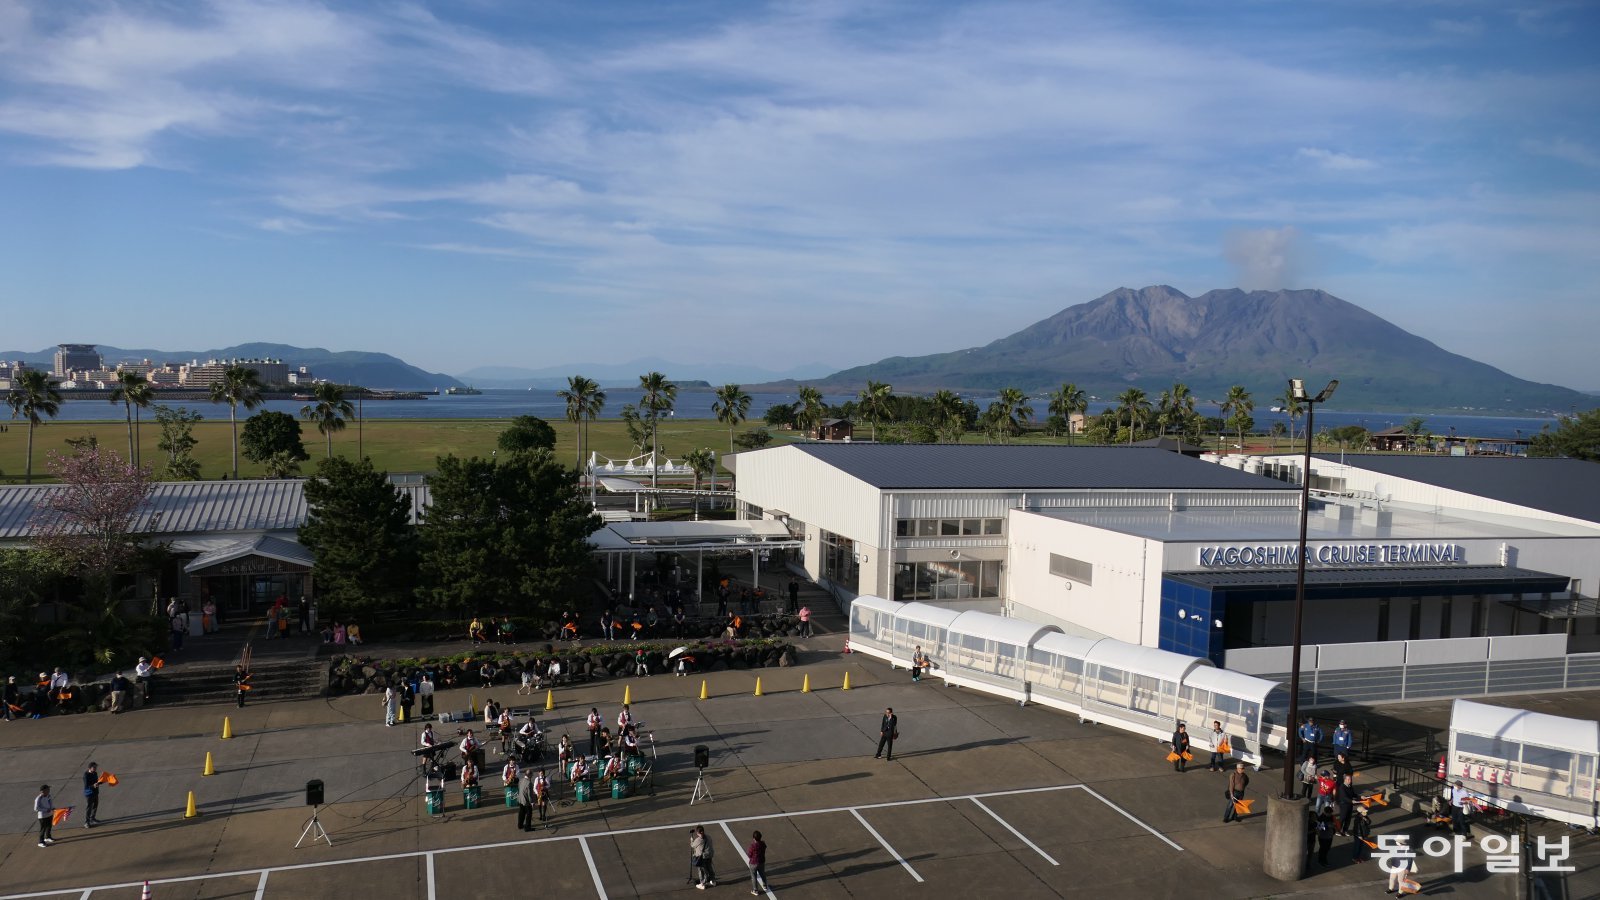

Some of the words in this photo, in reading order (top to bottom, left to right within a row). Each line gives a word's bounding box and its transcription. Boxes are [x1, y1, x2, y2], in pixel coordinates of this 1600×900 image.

[1199, 545, 1311, 565] KAGOSHIMA
[1317, 544, 1376, 563] CRUISE
[1381, 543, 1461, 562] TERMINAL
